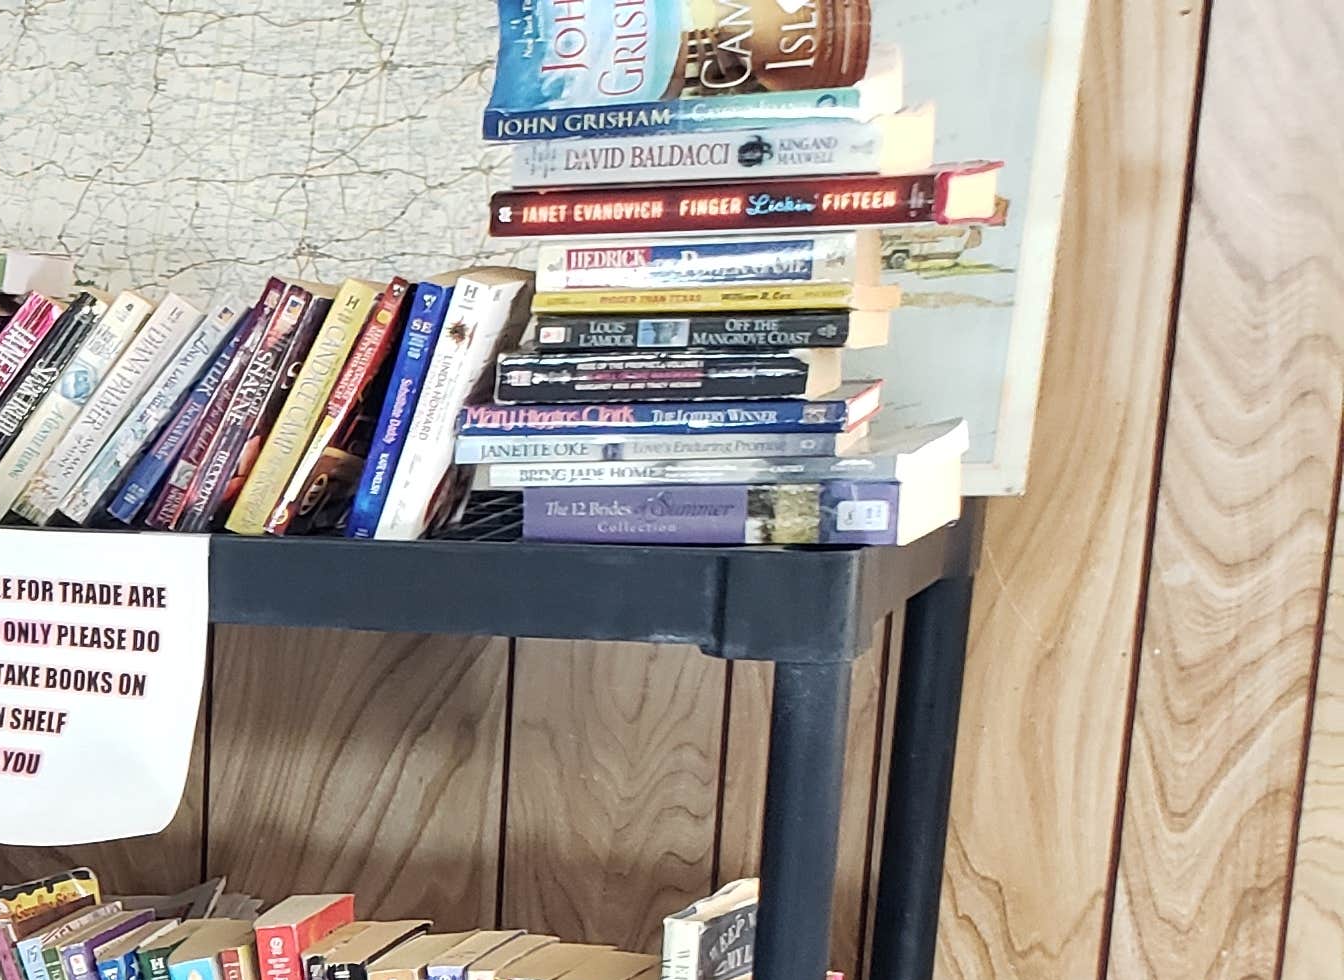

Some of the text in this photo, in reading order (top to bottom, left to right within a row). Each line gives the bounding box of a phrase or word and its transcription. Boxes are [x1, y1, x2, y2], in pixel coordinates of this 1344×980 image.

[498, 108, 671, 137] JOHN GRISHAM
[564, 142, 729, 171] DAVID BALDACCI
[523, 205, 567, 222] JANET
[573, 201, 663, 221] EVANOVICH
[680, 198, 741, 216] FINGER
[823, 191, 896, 210] FIFTEEN
[571, 249, 647, 269] HEDRICK
[589, 320, 626, 334] LOUIS
[725, 319, 780, 331] OFF THE
[579, 334, 634, 346] L'AMOUR
[693, 331, 810, 345] MANGROVE COAST
[581, 405, 635, 423] Clark
[481, 443, 589, 460] JANETTE OKE
[611, 466, 655, 479] HOME
[546, 501, 632, 516] The 12 Brides
[597, 522, 676, 533] Collection
[17, 580, 54, 601] FOR
[59, 582, 122, 605] TRADE
[128, 585, 166, 608] ARE
[4, 622, 52, 645] ONLY
[57, 625, 126, 650] PLEASE
[133, 630, 160, 652] DO
[45, 668, 112, 694] BOOKS
[119, 674, 146, 696] ON
[10, 708, 66, 734] SHELF
[2, 752, 40, 774] YOU
